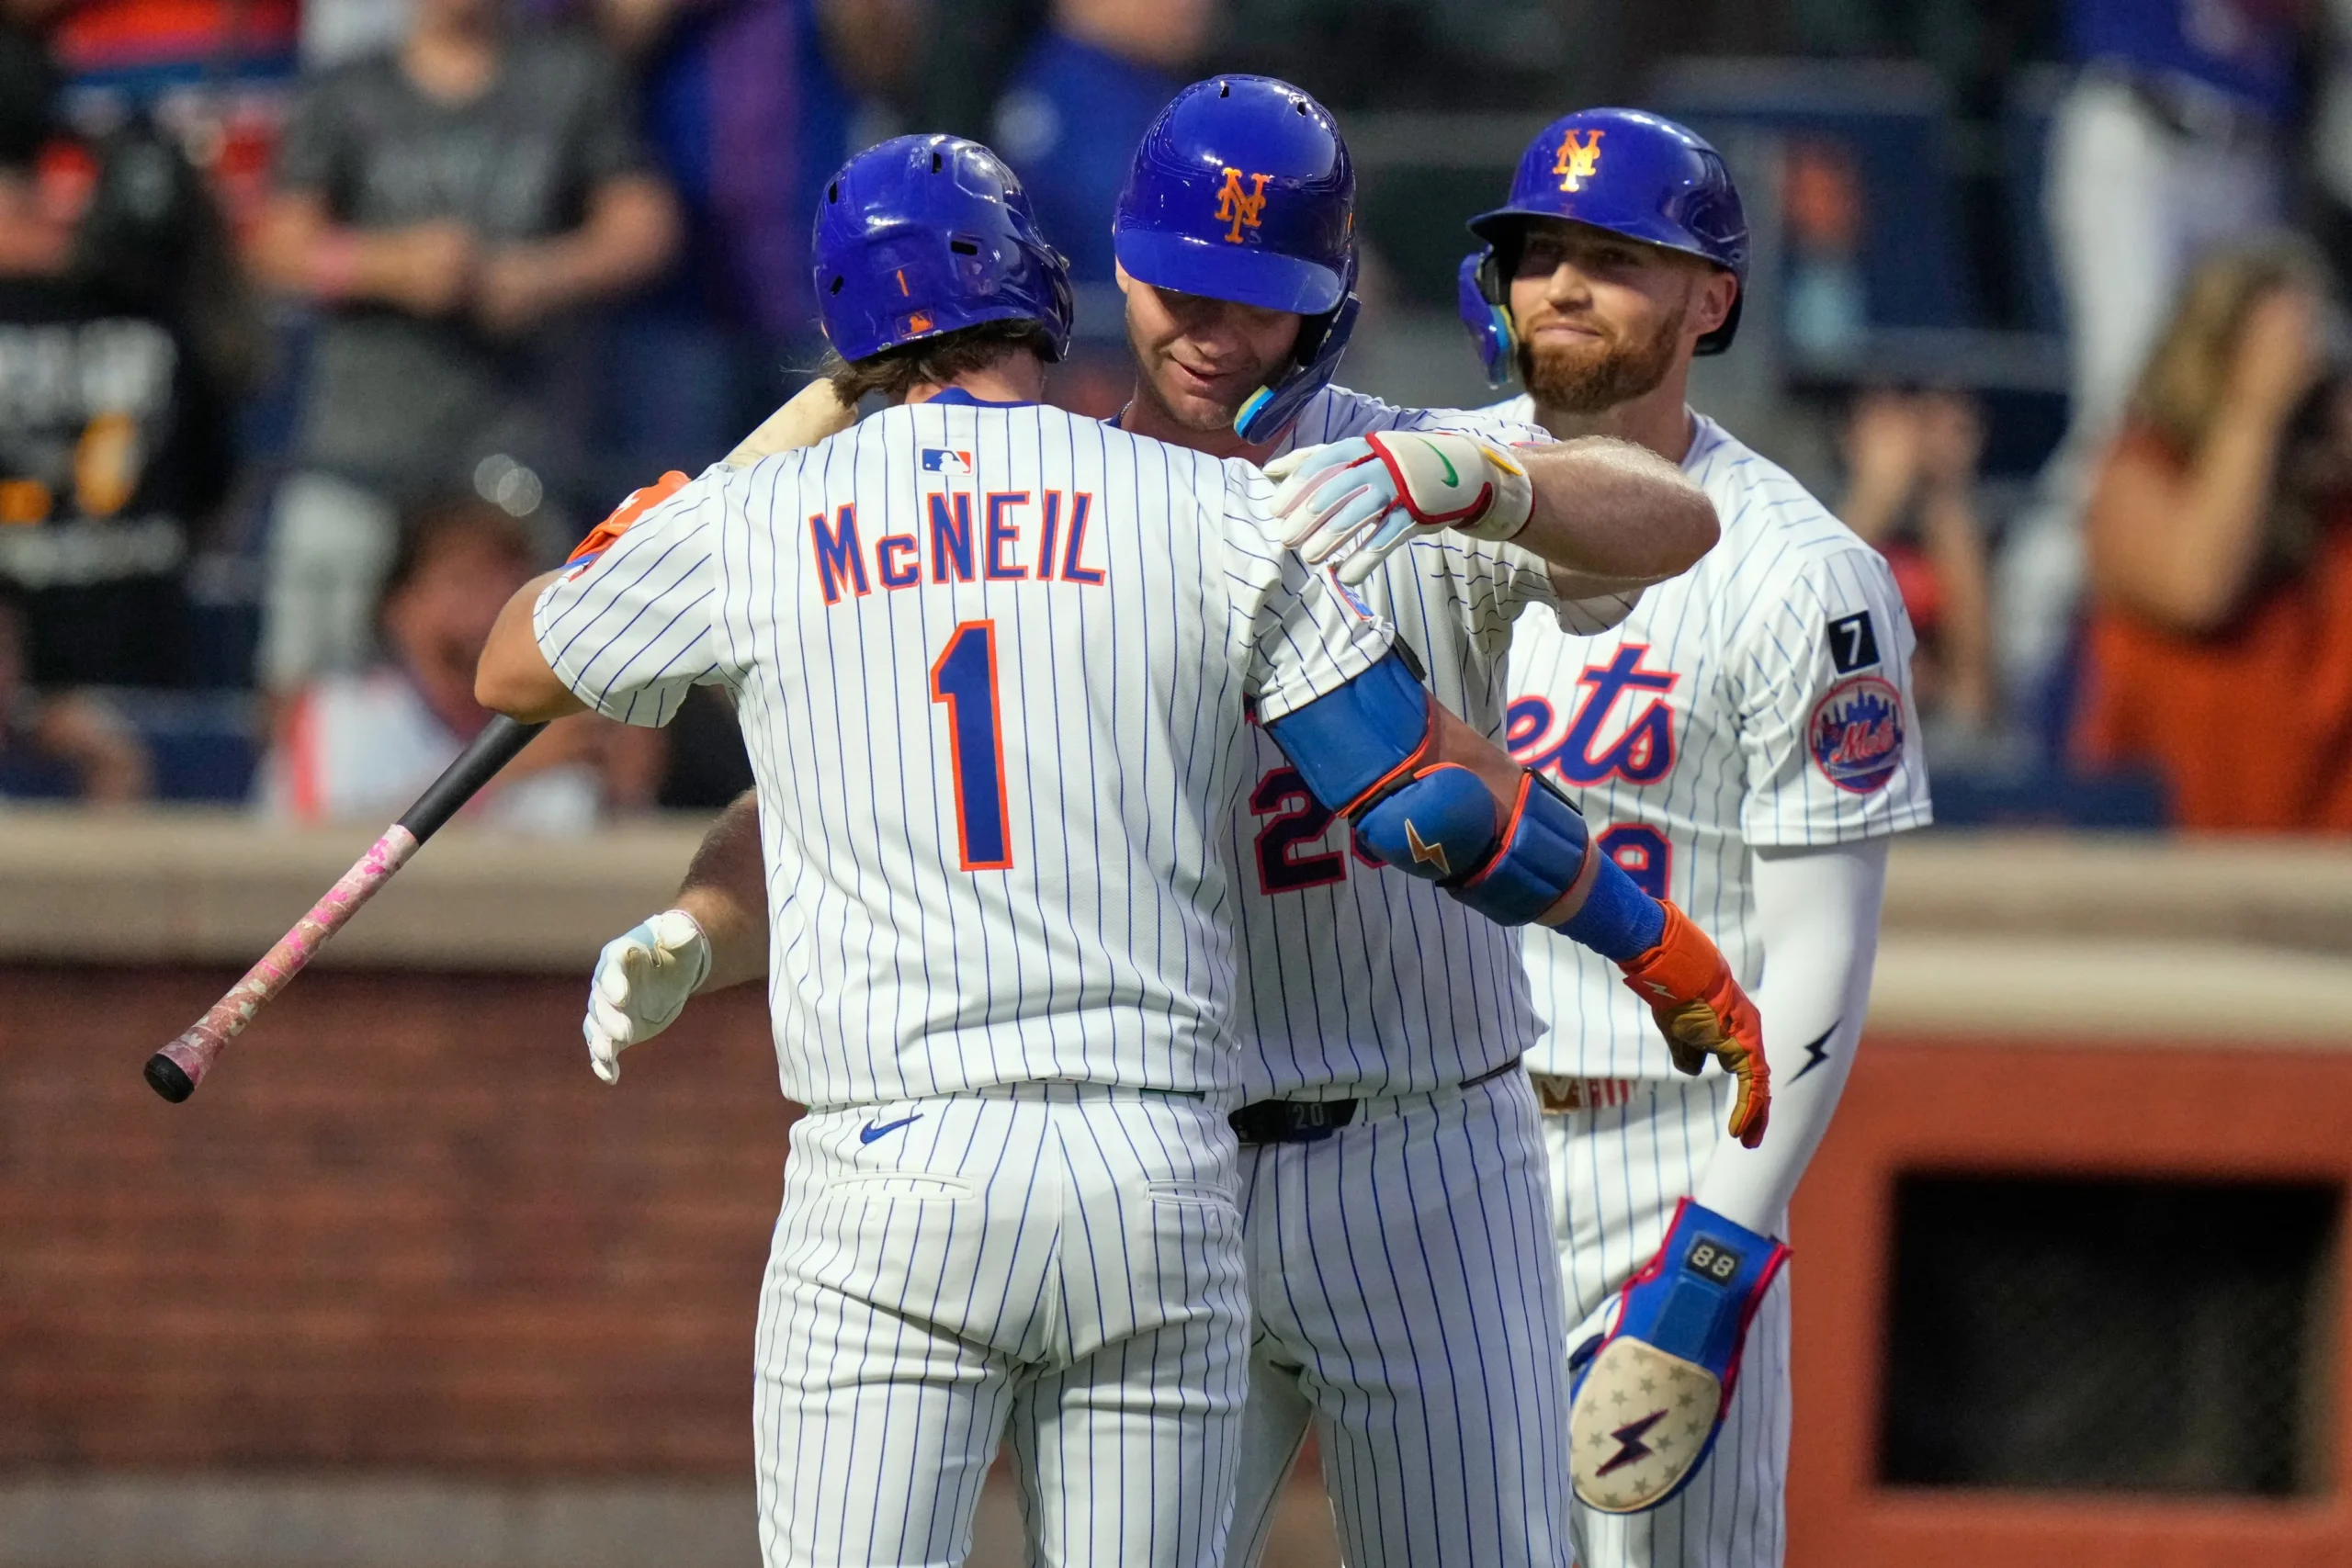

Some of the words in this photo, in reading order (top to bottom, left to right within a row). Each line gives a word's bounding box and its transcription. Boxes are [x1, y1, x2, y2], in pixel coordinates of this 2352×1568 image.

[809, 489, 1106, 606] McNEIL
[1840, 619, 1862, 666] 7
[930, 619, 1013, 871] 1
[1507, 643, 1680, 787] ets
[1250, 766, 1392, 896] 2
[1292, 1102, 1325, 1129] 20
[1692, 1245, 1735, 1277] 88
